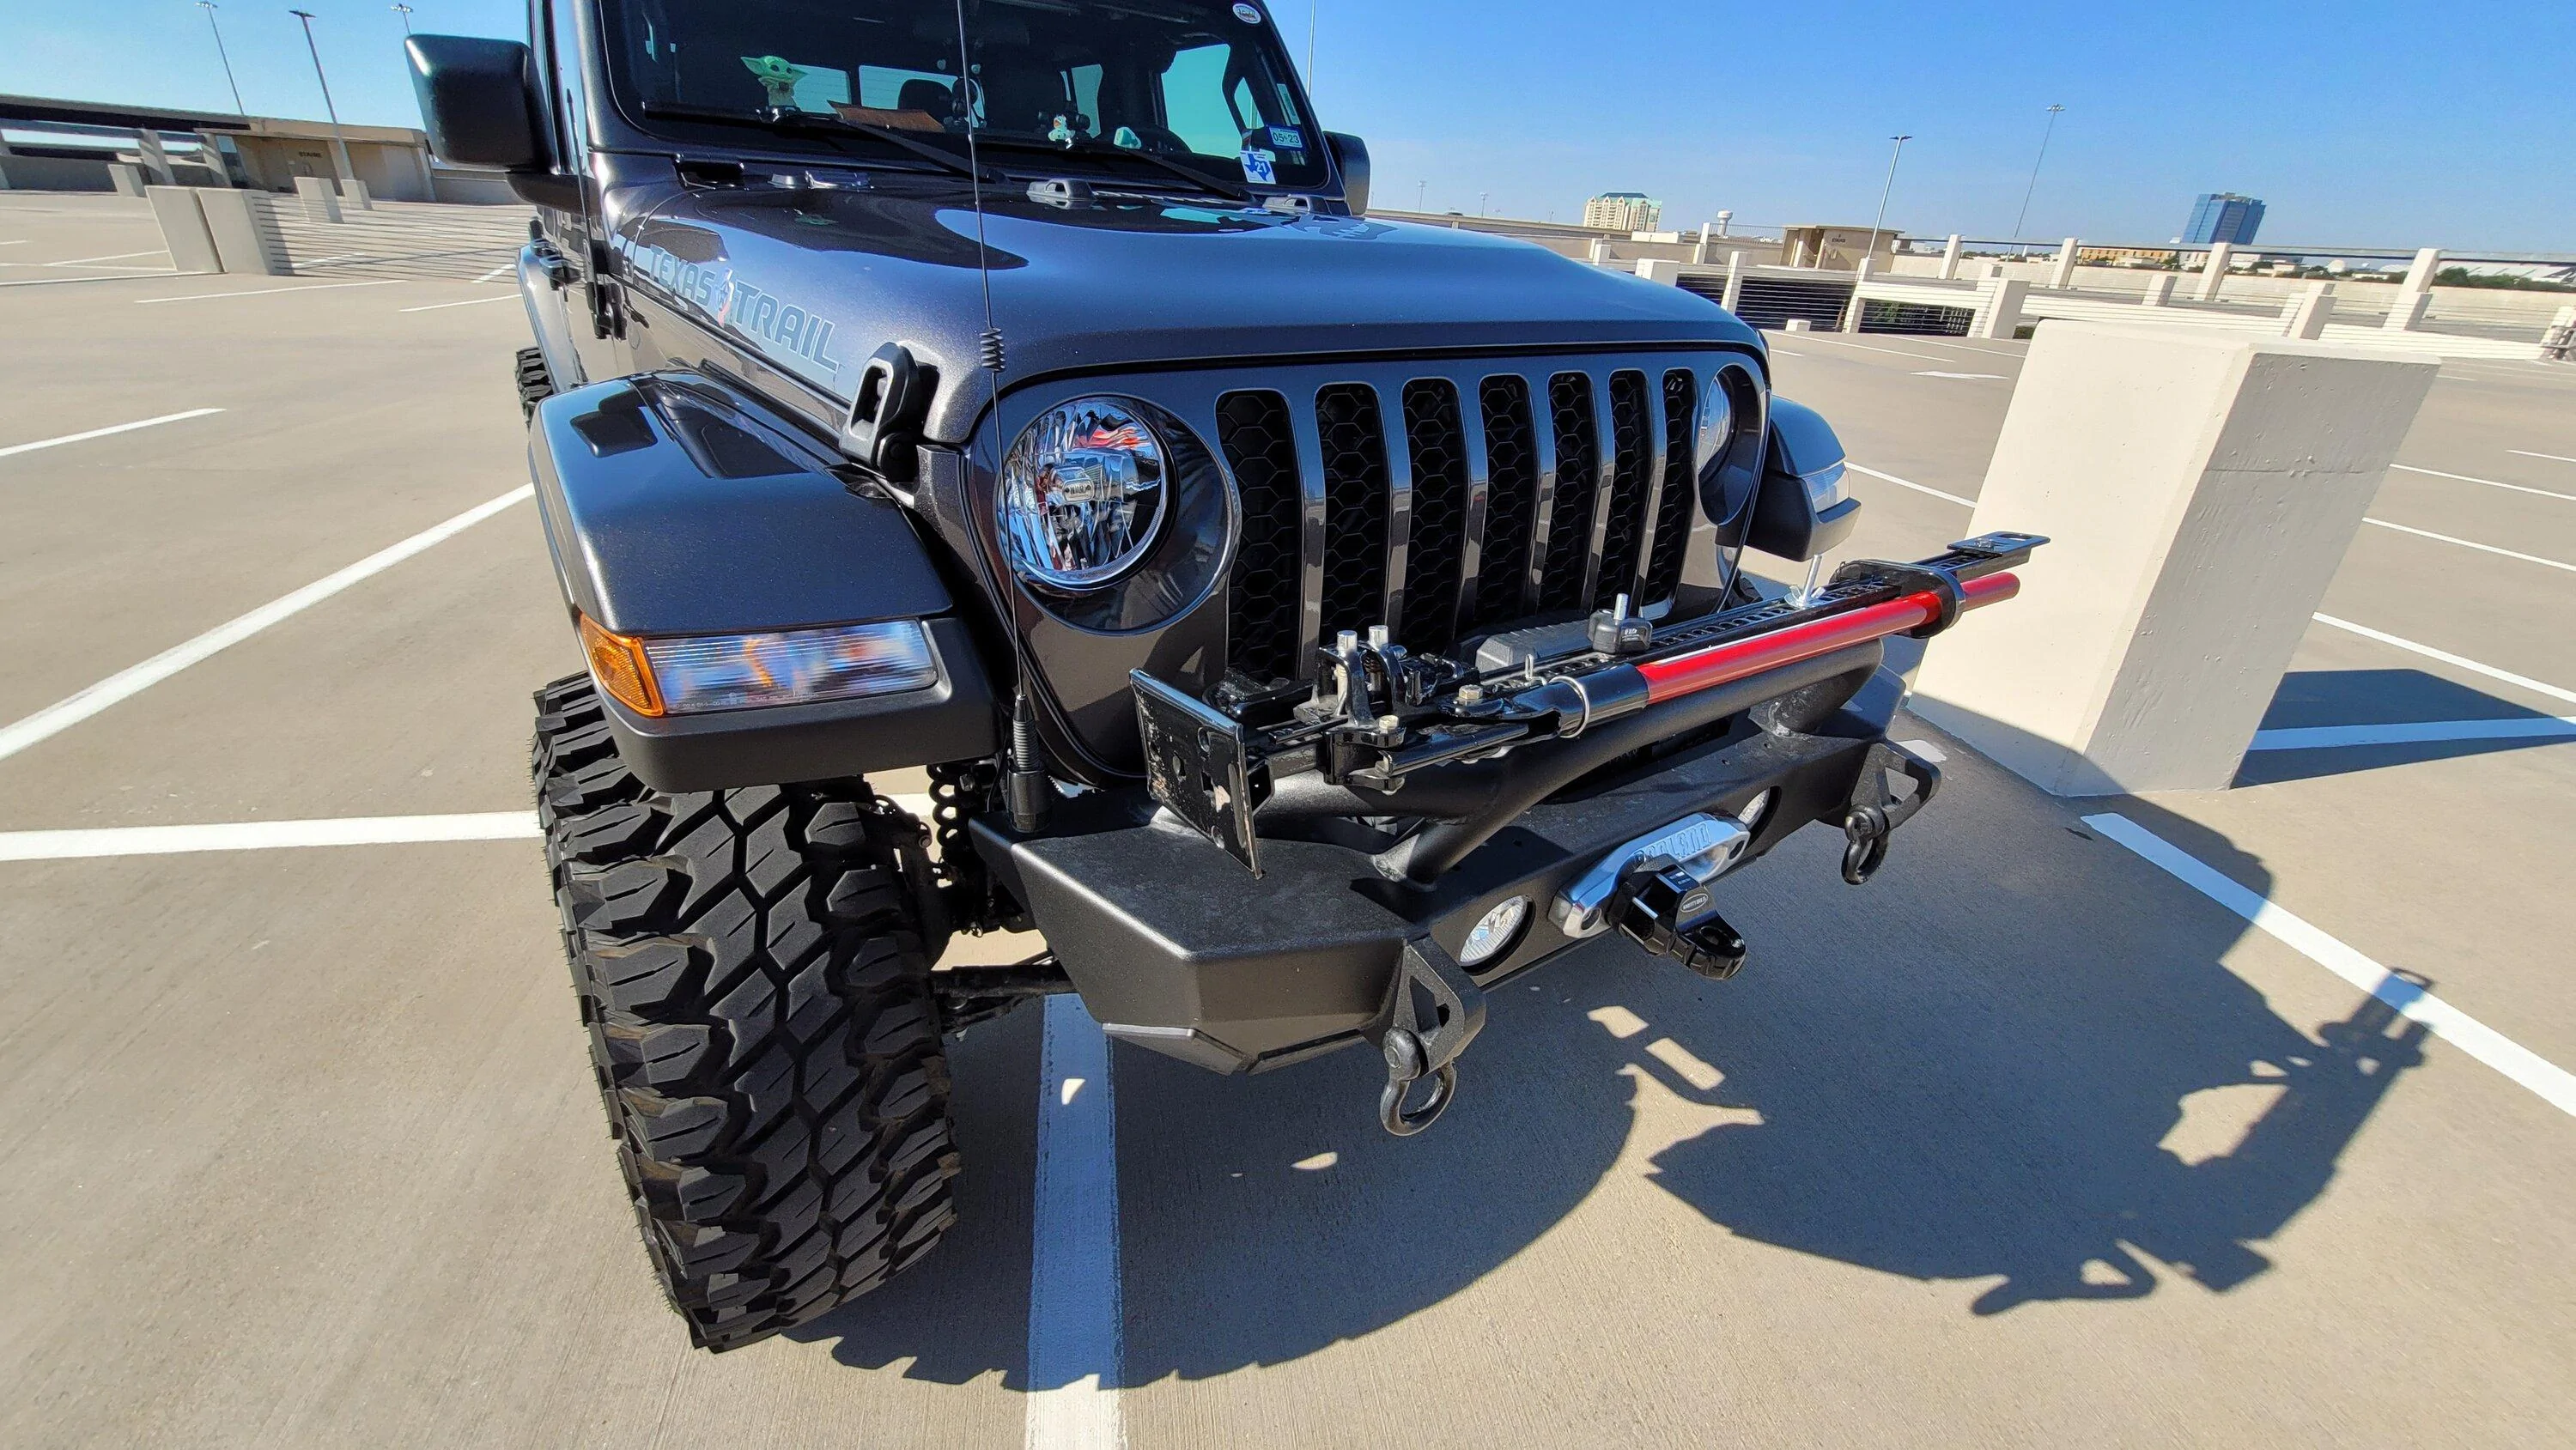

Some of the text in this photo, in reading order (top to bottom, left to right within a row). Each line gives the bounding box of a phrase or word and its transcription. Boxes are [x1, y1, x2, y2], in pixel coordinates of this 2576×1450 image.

[1272, 131, 1300, 143] 05 23
[1255, 161, 1267, 173] 21
[648, 244, 840, 373] TEXAS TRAIL
